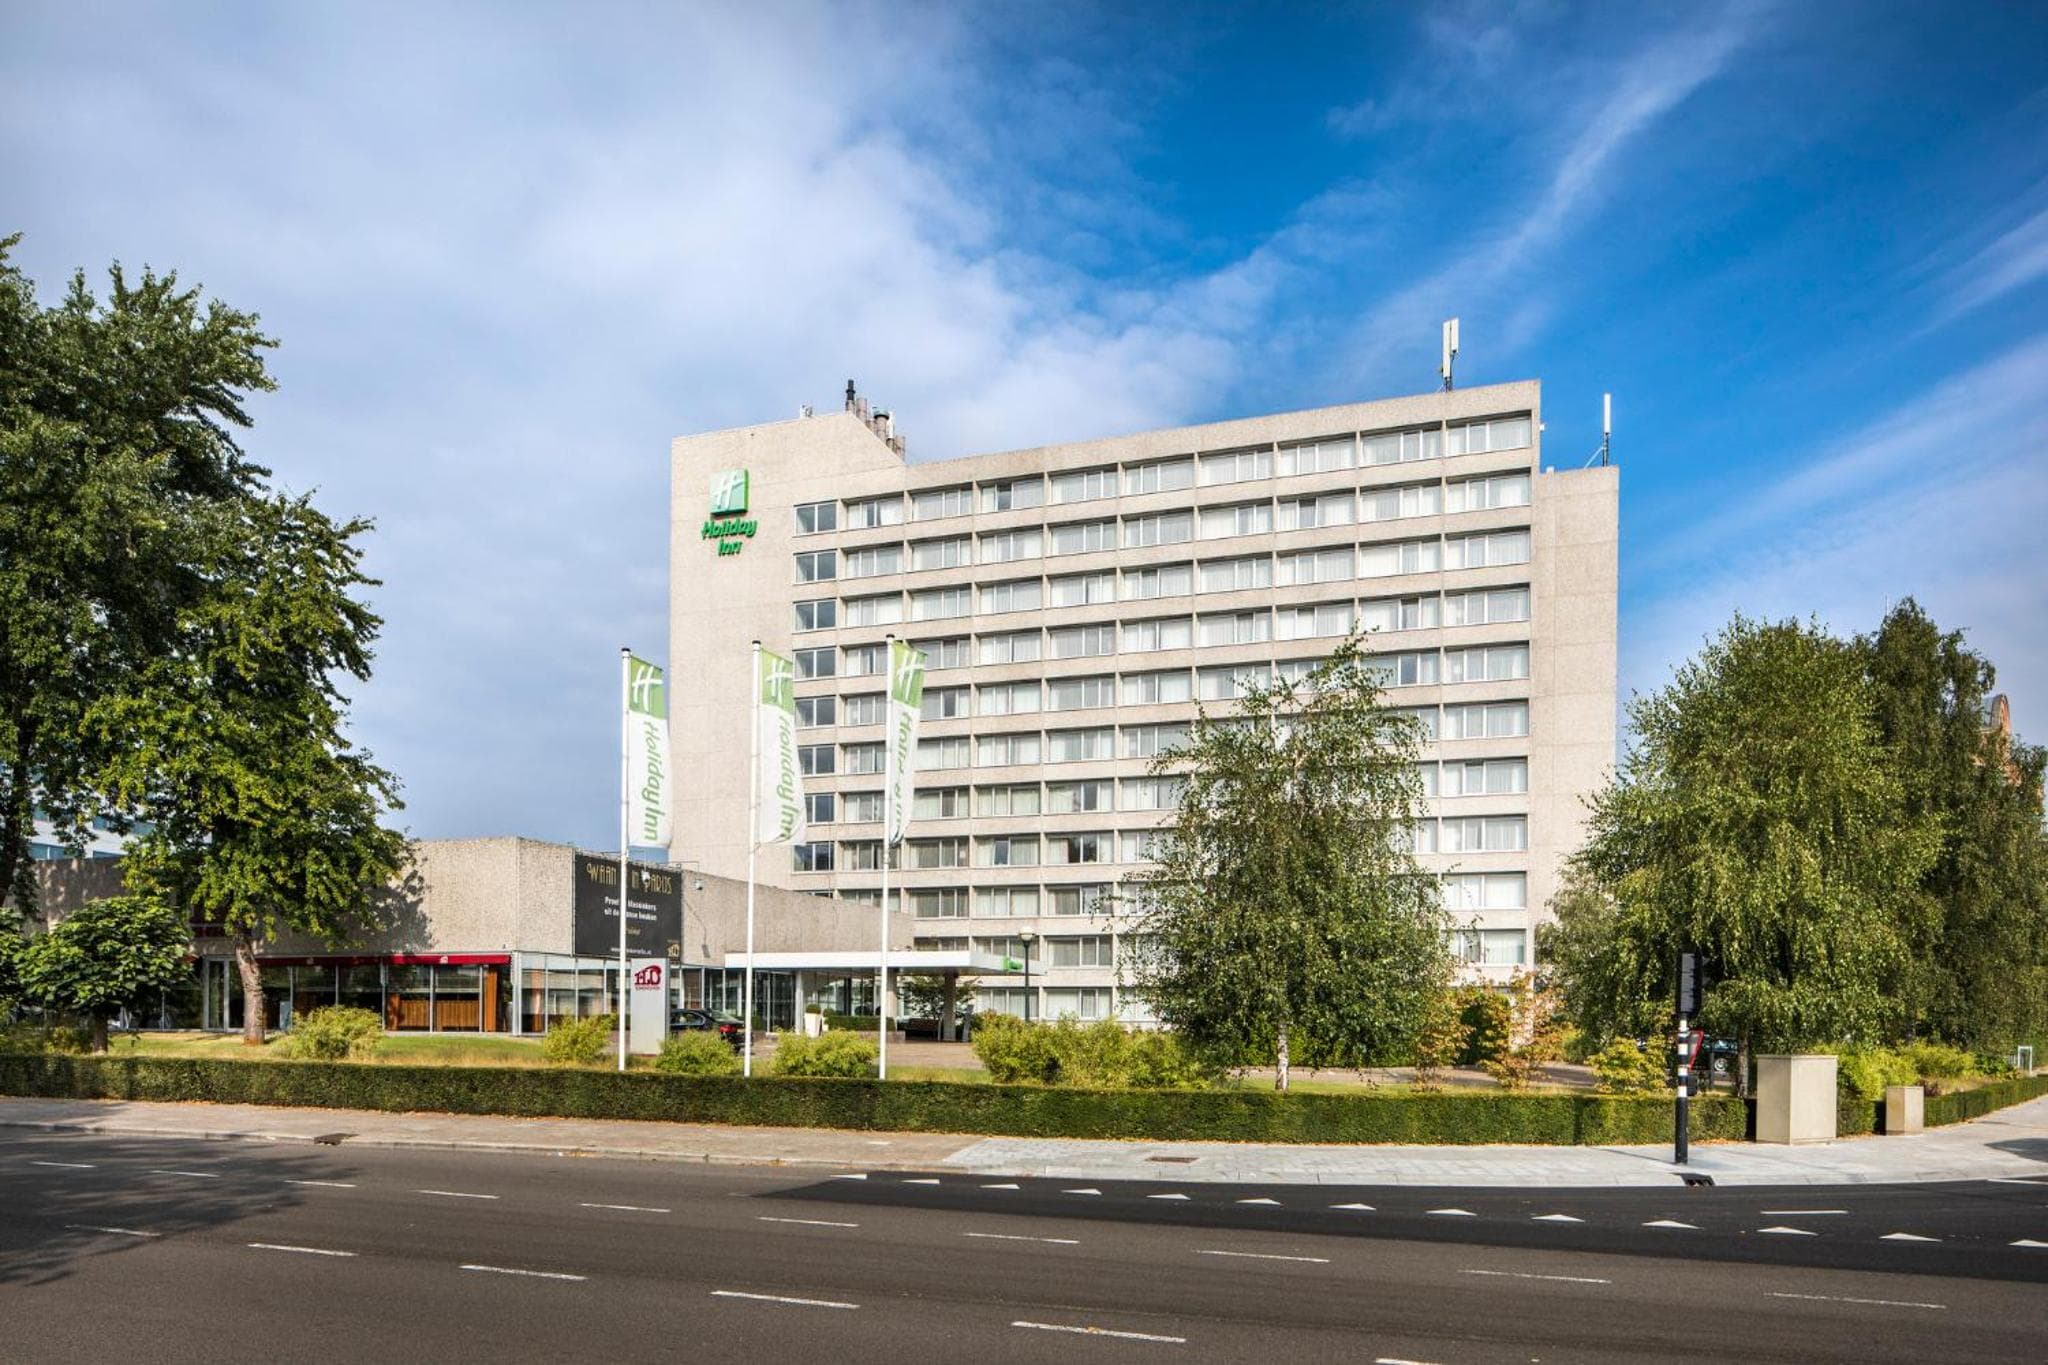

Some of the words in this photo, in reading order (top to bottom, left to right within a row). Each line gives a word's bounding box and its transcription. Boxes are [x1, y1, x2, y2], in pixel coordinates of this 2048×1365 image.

[702, 519, 757, 537] Holiday
[719, 540, 741, 554] Inn
[641, 720, 664, 804] Holiday
[777, 716, 796, 801] Holiday
[644, 807, 665, 841] Inn
[780, 804, 799, 839] Inn
